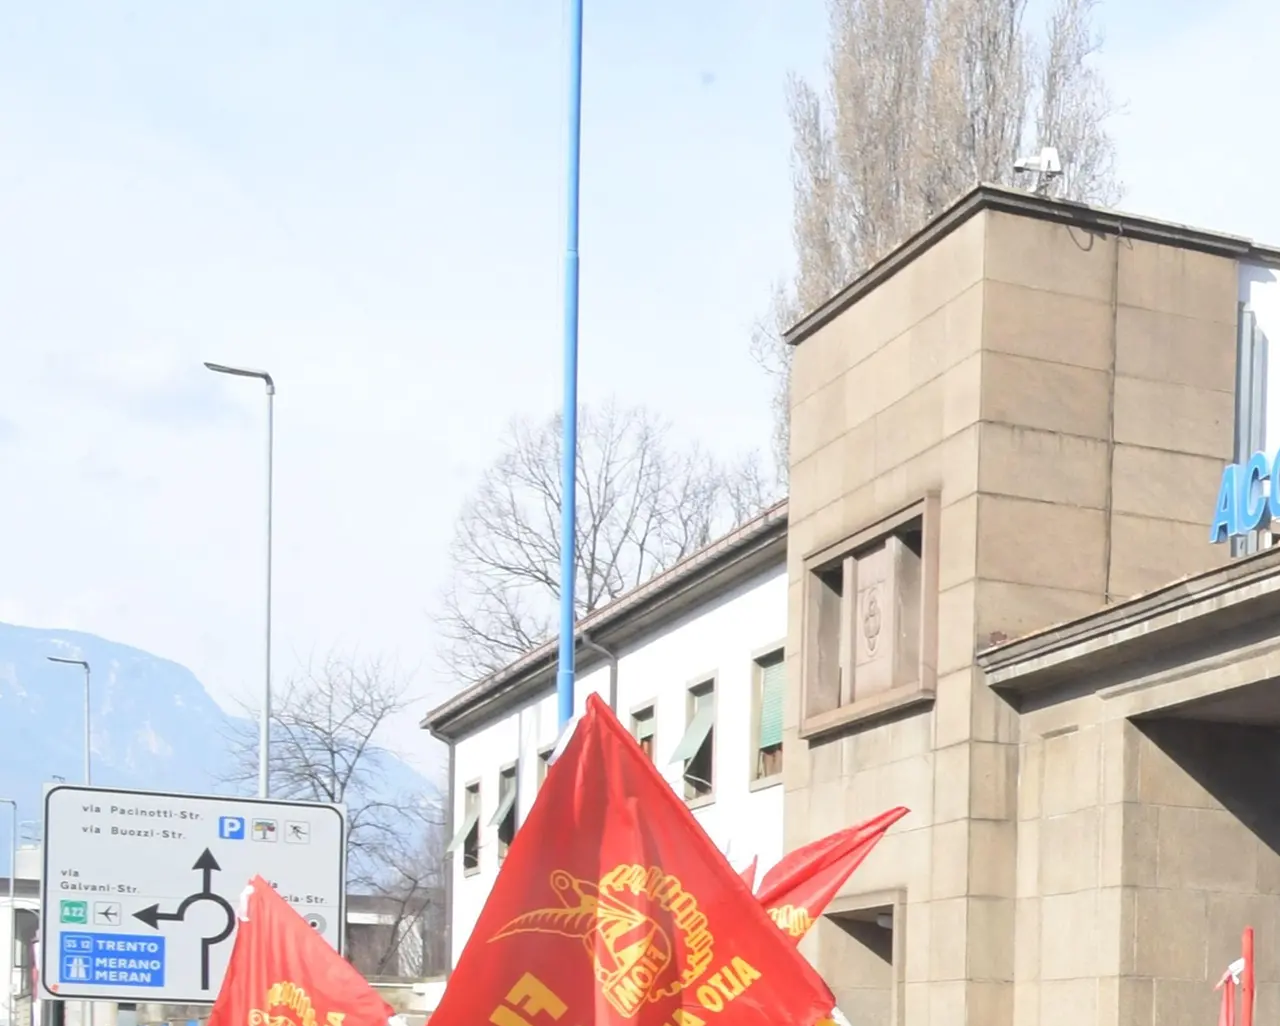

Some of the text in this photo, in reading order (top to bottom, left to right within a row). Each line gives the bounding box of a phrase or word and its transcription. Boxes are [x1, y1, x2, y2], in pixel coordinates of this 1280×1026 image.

[82, 804, 204, 821] via Pacinotti-Str.
[82, 825, 187, 840] via Buozzi-Str.
[224, 819, 241, 837] P
[61, 869, 80, 877] via
[60, 881, 141, 894] Galvani-Str.
[96, 939, 159, 954] TRENTO
[95, 956, 162, 971] MERANO
[95, 969, 152, 984] MERAN
